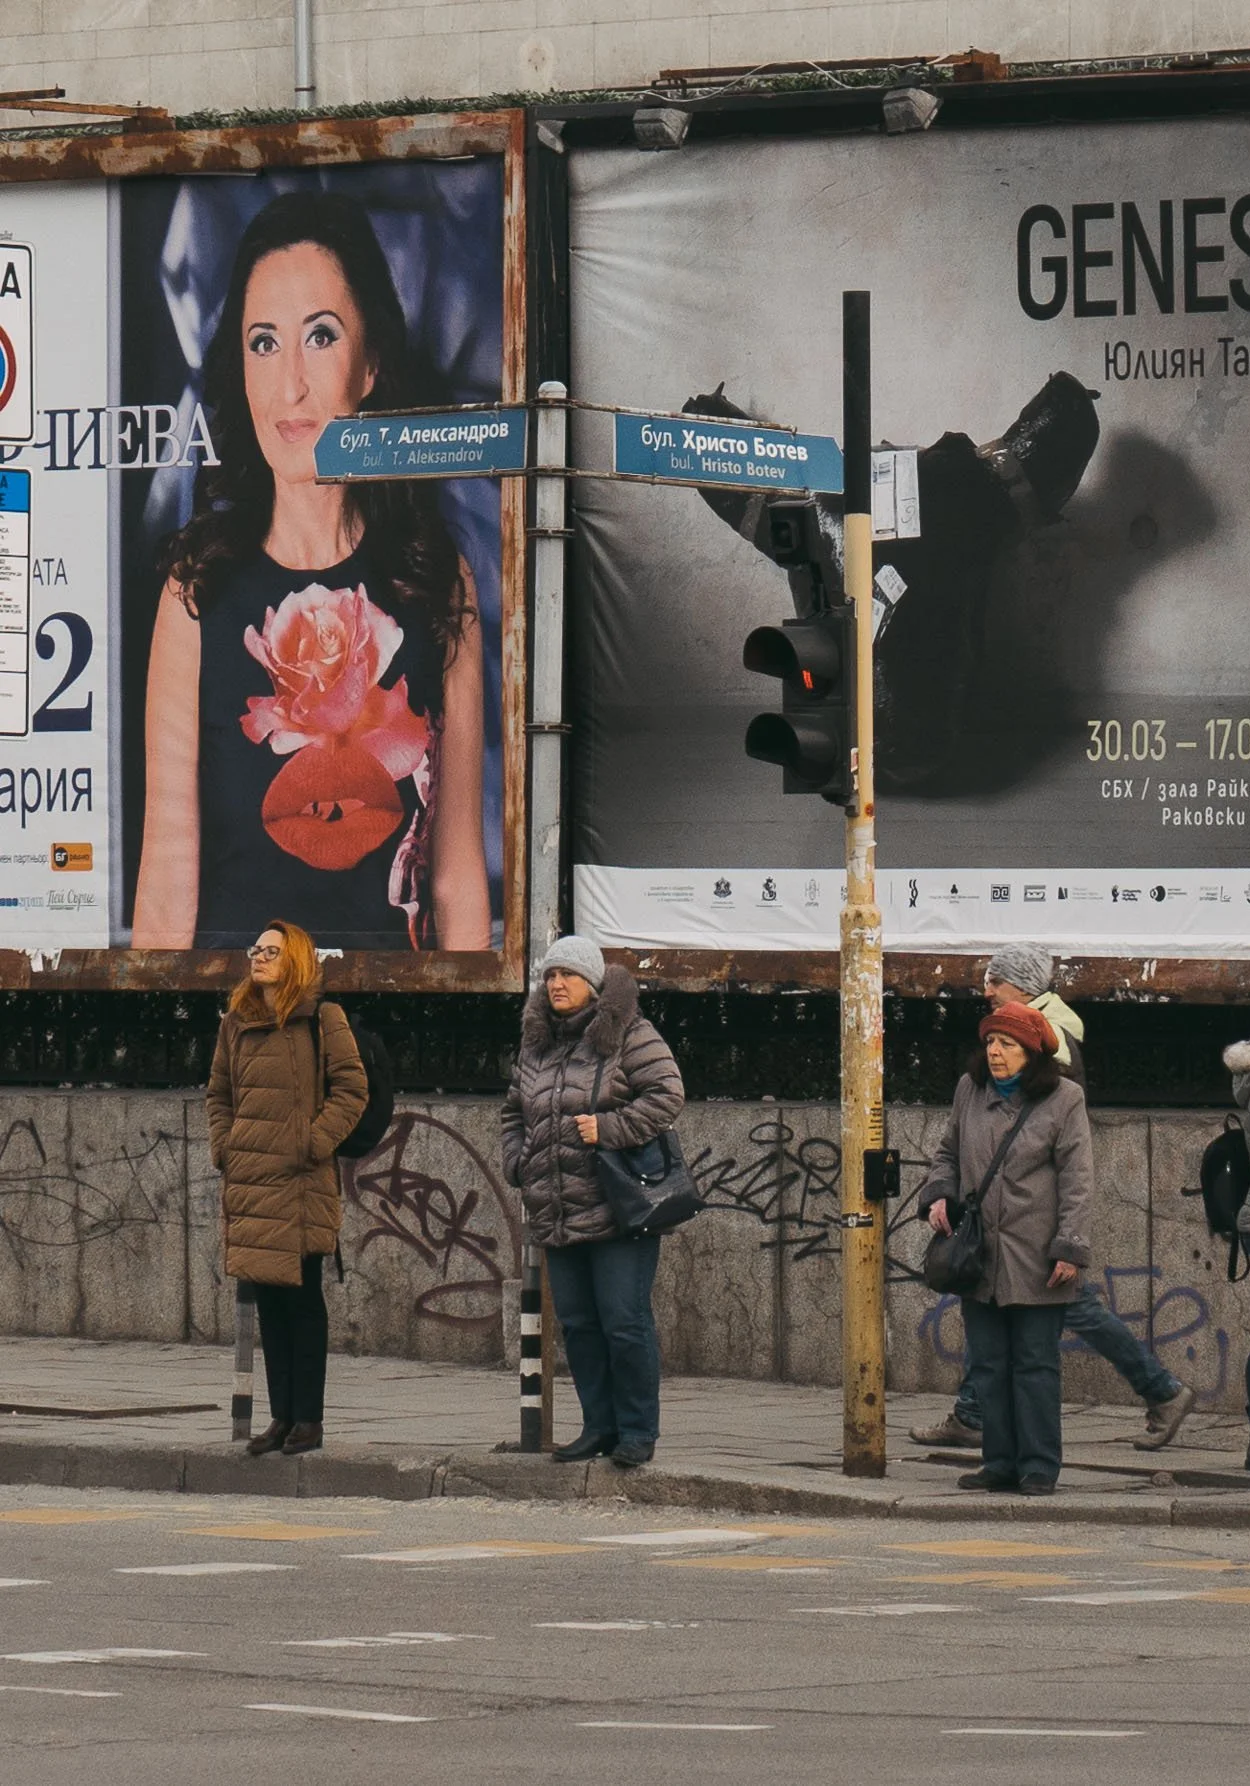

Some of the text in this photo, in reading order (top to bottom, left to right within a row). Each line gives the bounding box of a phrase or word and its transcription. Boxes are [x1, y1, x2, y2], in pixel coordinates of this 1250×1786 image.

[1105, 340, 1205, 381] Юлиян
[340, 421, 509, 453] бул. Т. Александров
[641, 424, 809, 461] бул. Христо Ботев
[362, 452, 384, 468] bul.
[407, 448, 484, 465] Aleksandrov
[670, 452, 786, 480] bul. Hristo Botev
[1086, 719, 1167, 762] 30.03
[1101, 778, 1133, 799] СБХ
[1158, 781, 1198, 802] зала
[1161, 806, 1245, 826] Раковски
